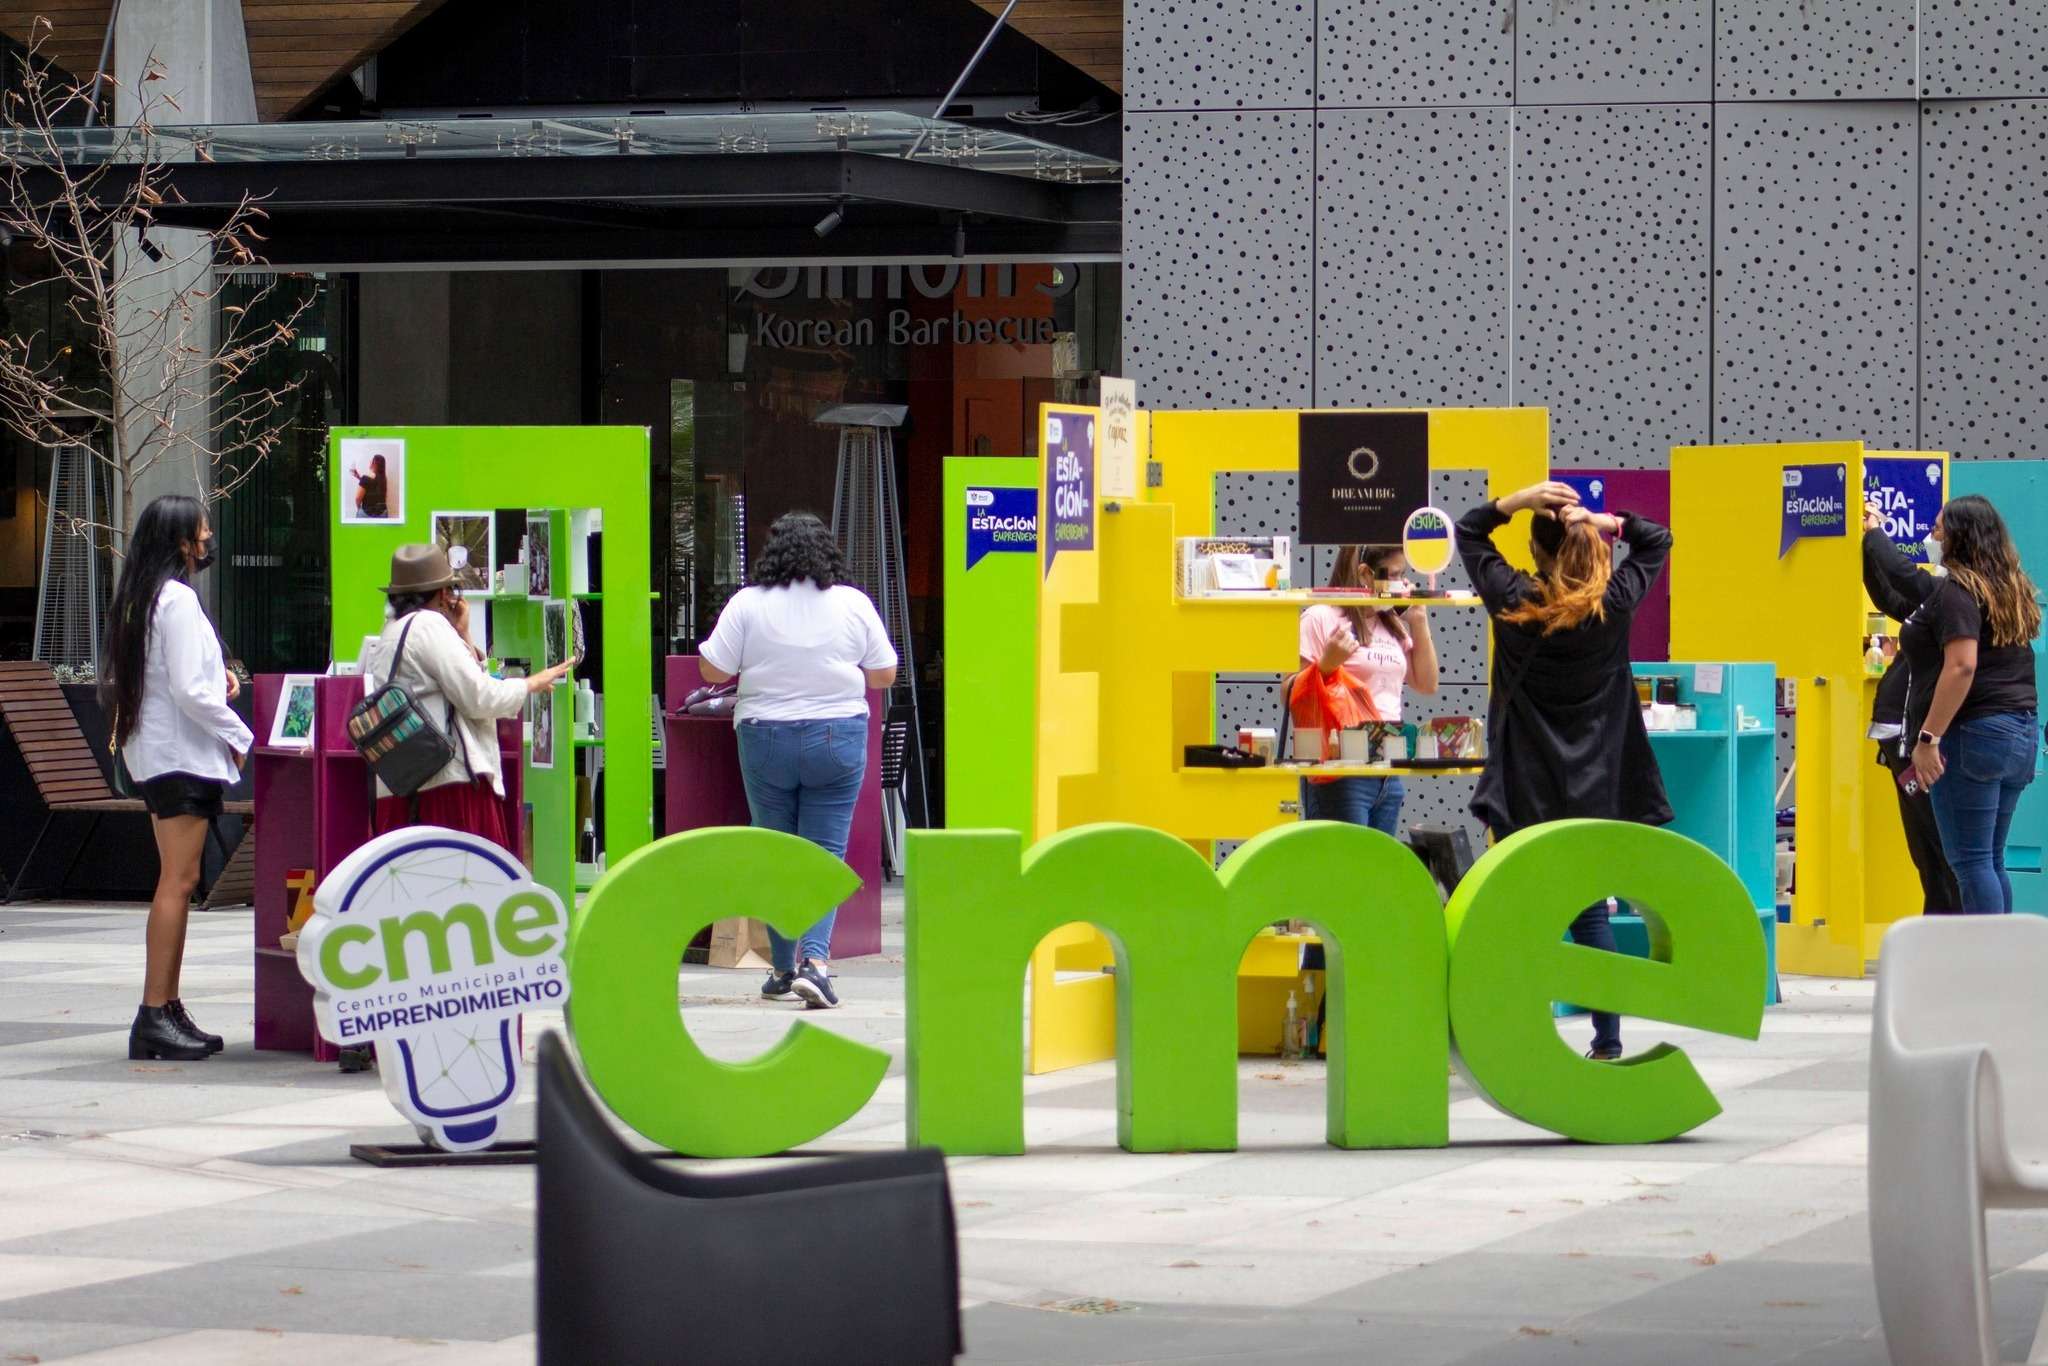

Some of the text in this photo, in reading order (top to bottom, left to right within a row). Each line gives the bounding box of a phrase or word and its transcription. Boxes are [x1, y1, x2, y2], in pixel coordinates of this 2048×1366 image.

[756, 308, 1056, 347] Korean Barbecue
[1056, 451, 1083, 482] ESTA-
[1868, 475, 1880, 489] LA
[1055, 480, 1083, 519] CIÓN
[1332, 487, 1396, 499] DREAM BIG
[1786, 496, 1834, 514] ESTACIÓN
[972, 515, 1037, 531] ESTACIÓN
[977, 507, 986, 517] LA
[1915, 523, 1930, 531] DEL
[319, 891, 561, 991] cme
[336, 962, 560, 1014] Centro Municipal de
[567, 820, 1766, 1158] cme
[338, 979, 563, 1038] EMPRENDIMIENTO
